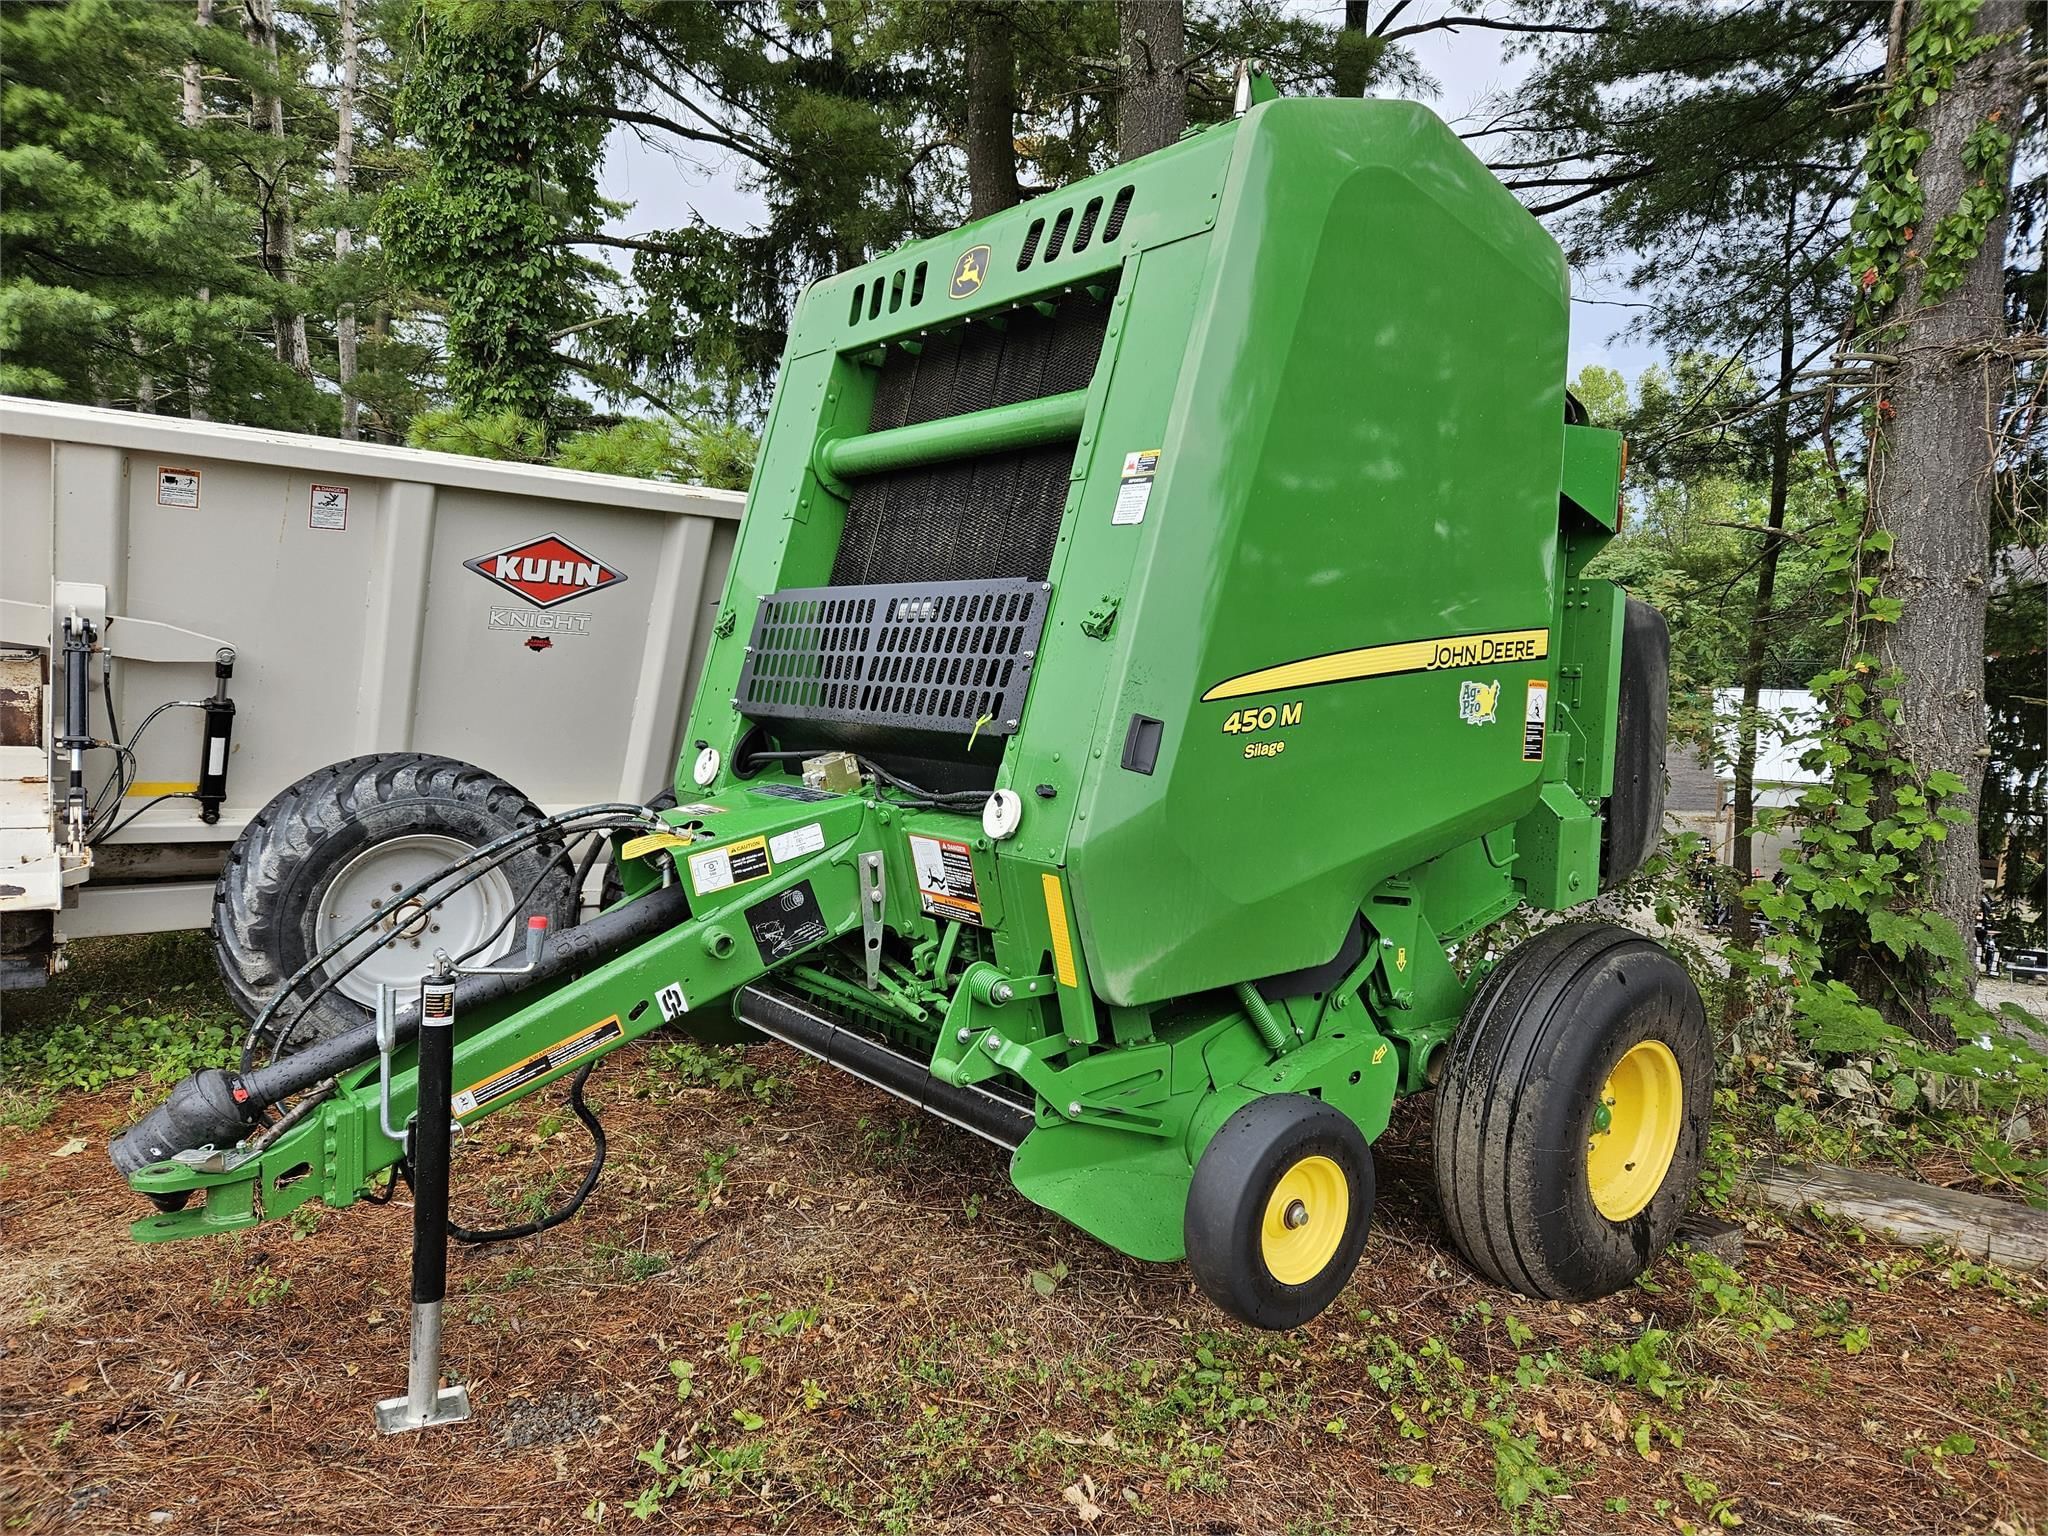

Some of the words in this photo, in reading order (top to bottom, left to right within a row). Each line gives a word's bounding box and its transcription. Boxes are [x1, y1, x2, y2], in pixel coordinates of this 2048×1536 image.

[494, 554, 601, 587] KUHN
[488, 610, 592, 631] KNIGHT
[1427, 644, 1477, 667] JOHN
[1480, 639, 1536, 661] DEERE
[1462, 700, 1481, 715] Pro
[1222, 705, 1278, 735] 450
[1280, 701, 1304, 728] M
[1243, 740, 1286, 759] Silage
[736, 841, 761, 852] CAUTION
[947, 843, 966, 853] DANGER
[532, 1043, 563, 1060] WARNING
